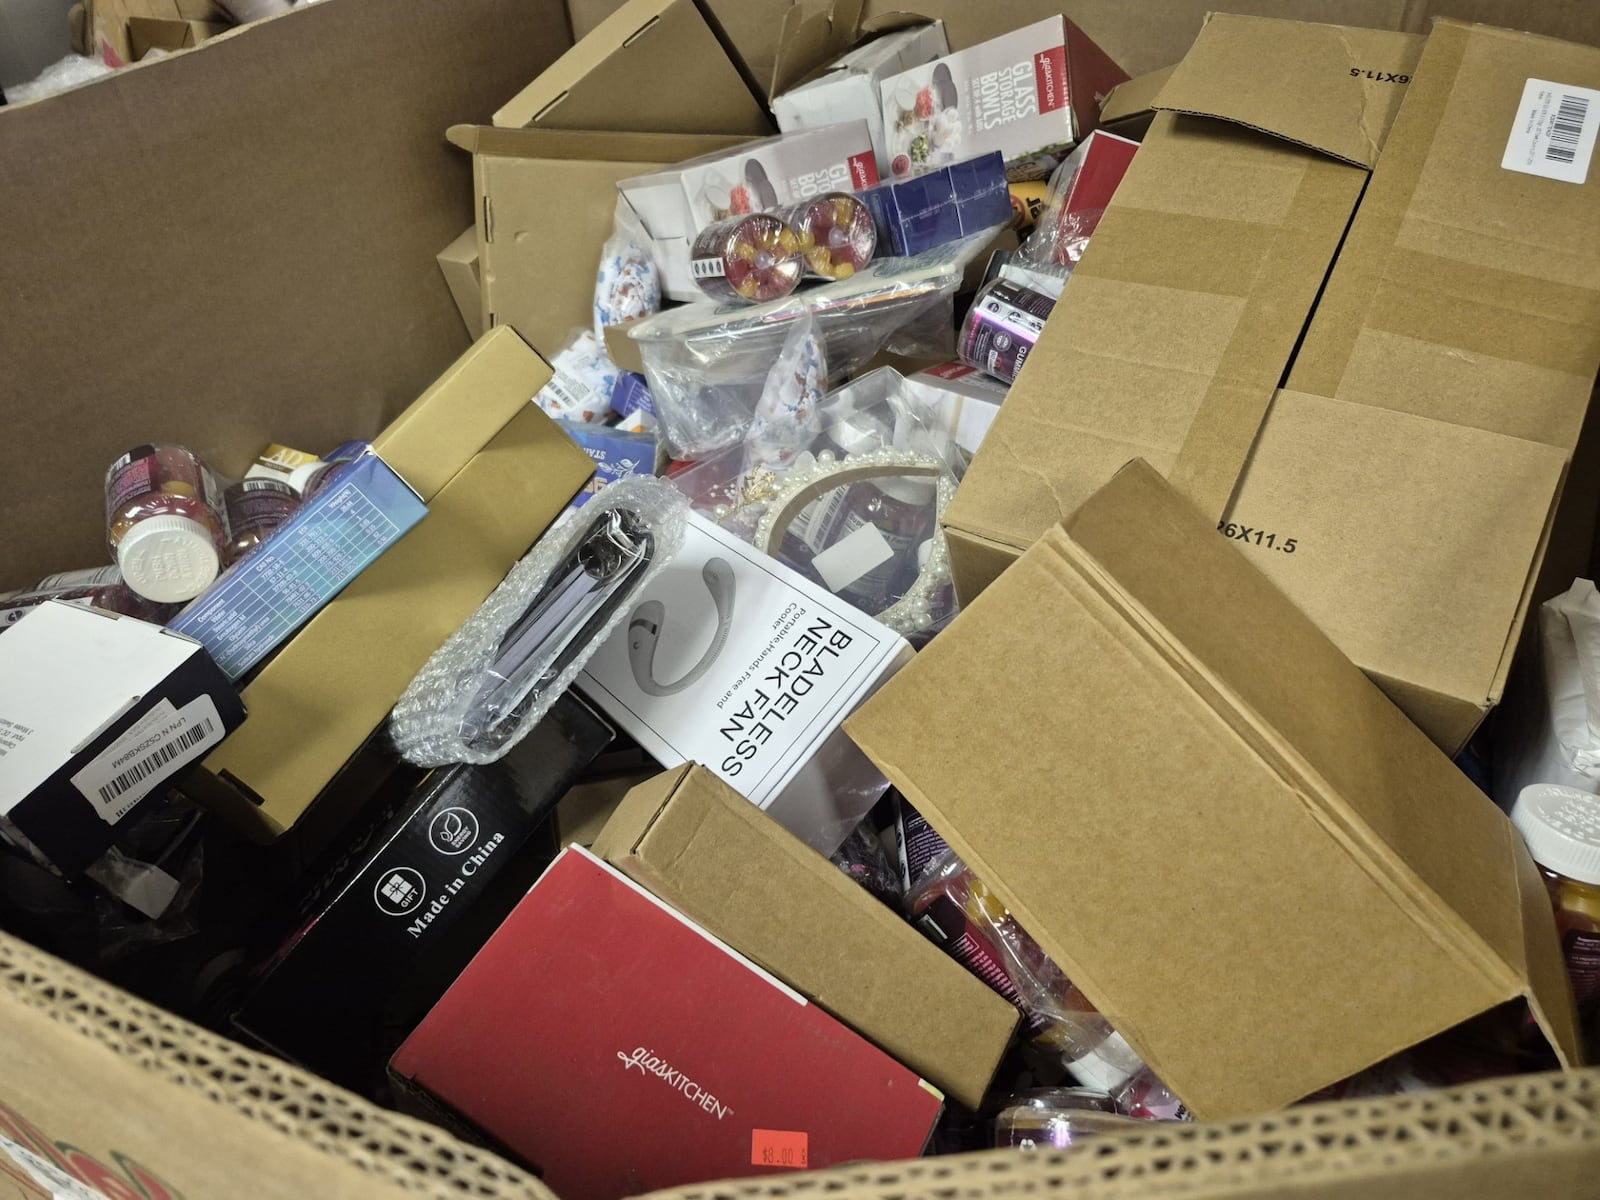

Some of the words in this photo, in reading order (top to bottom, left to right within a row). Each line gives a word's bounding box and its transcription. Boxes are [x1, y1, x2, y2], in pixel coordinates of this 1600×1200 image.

[1349, 67, 1413, 84] 6X11.5
[980, 72, 1001, 130] BOWLS
[999, 67, 1017, 125] STORAGE
[1012, 60, 1036, 118] GLASS
[772, 602, 798, 630] Cooler
[764, 617, 832, 690] NECK
[733, 671, 752, 691] Free
[717, 690, 733, 709] and
[721, 629, 853, 777] BLADELESS
[169, 716, 187, 732] LPN
[720, 688, 770, 742] FAN
[451, 825, 469, 847] ENERGY
[455, 830, 472, 849] SAVING
[400, 887, 419, 908] GIFT
[407, 894, 450, 938] Made
[445, 878, 465, 895] in
[461, 832, 505, 877] China
[762, 1146, 794, 1165] $8.00
